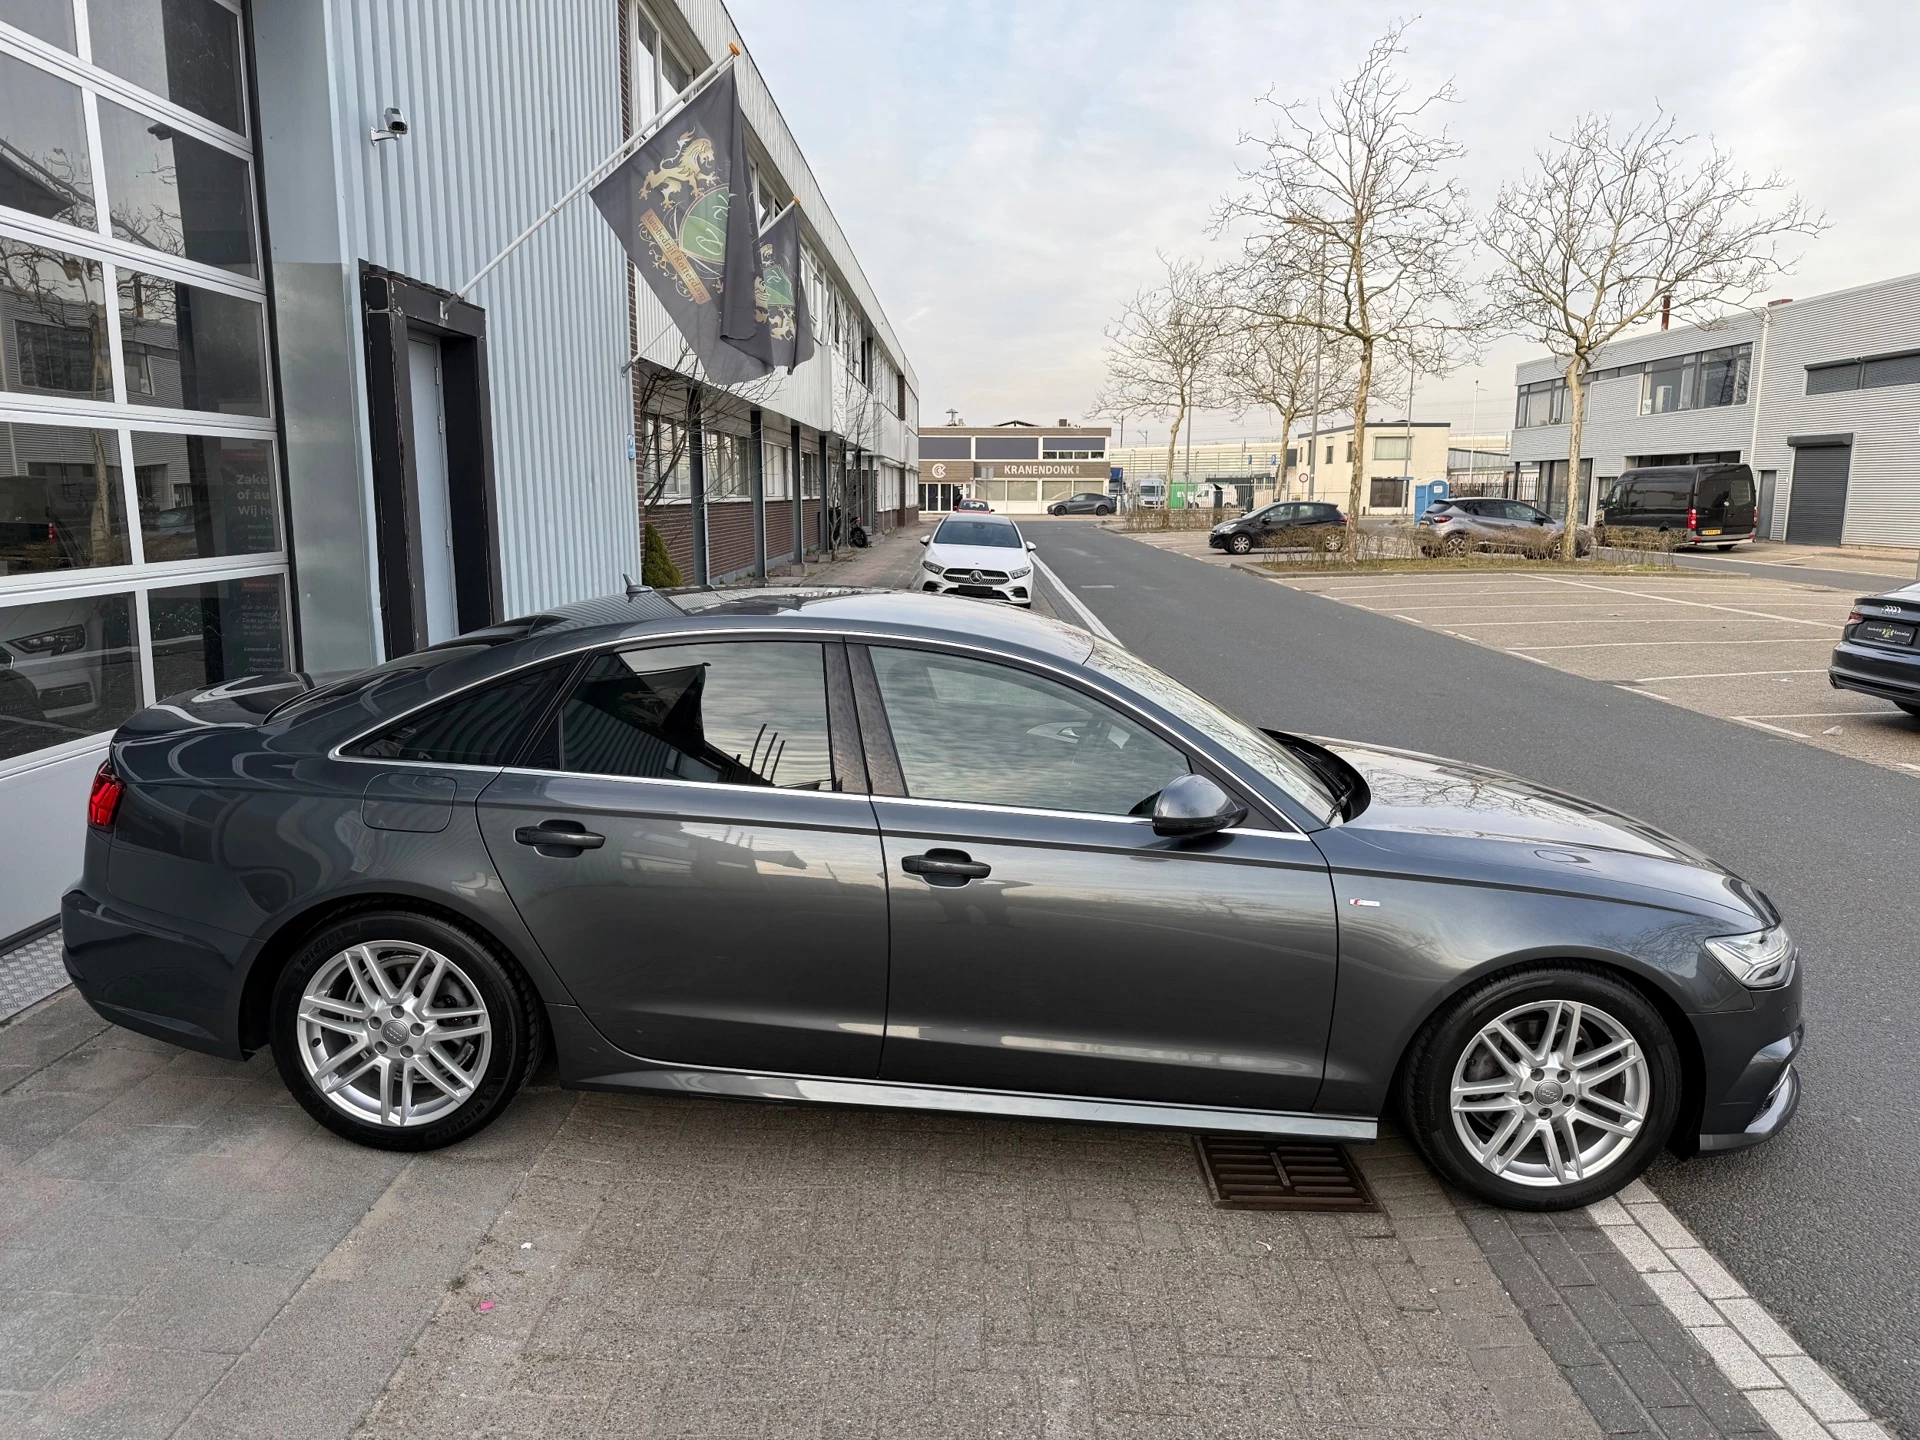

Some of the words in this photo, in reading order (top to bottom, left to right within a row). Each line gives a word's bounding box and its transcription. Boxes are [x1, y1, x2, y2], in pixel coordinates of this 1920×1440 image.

[646, 213, 680, 255] Autobedrijf
[673, 254, 707, 300] Rotterdam
[1004, 465, 1074, 475] KRANENDONK
[237, 489, 250, 500] of
[237, 505, 257, 517] Wij
